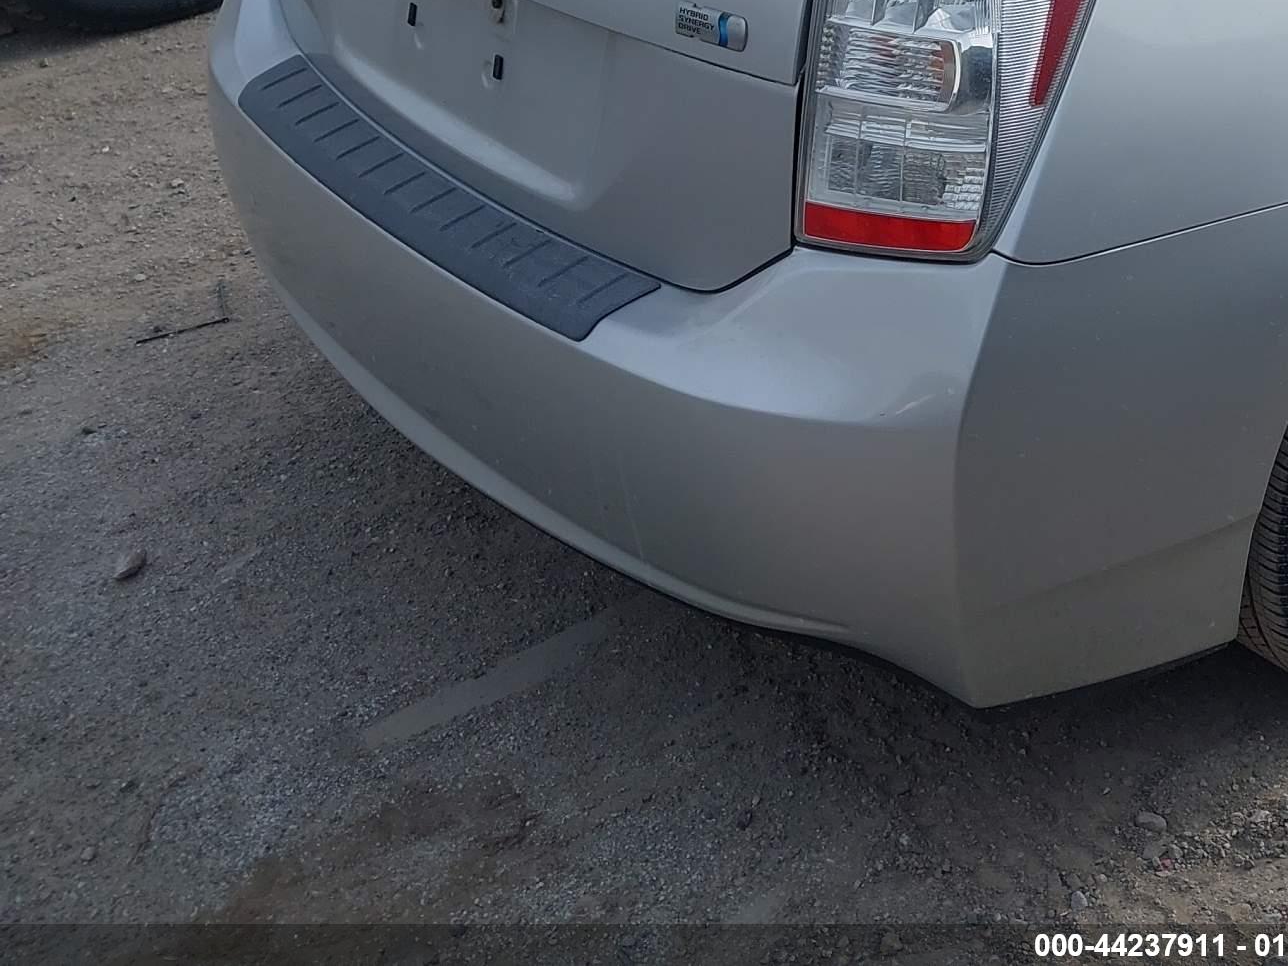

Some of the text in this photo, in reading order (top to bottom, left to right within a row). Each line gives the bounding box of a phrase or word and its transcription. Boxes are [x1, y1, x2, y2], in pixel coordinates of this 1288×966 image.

[679, 7, 709, 21] HYBRID
[678, 14, 715, 31] SYNERGY
[678, 22, 701, 35] DRIVE
